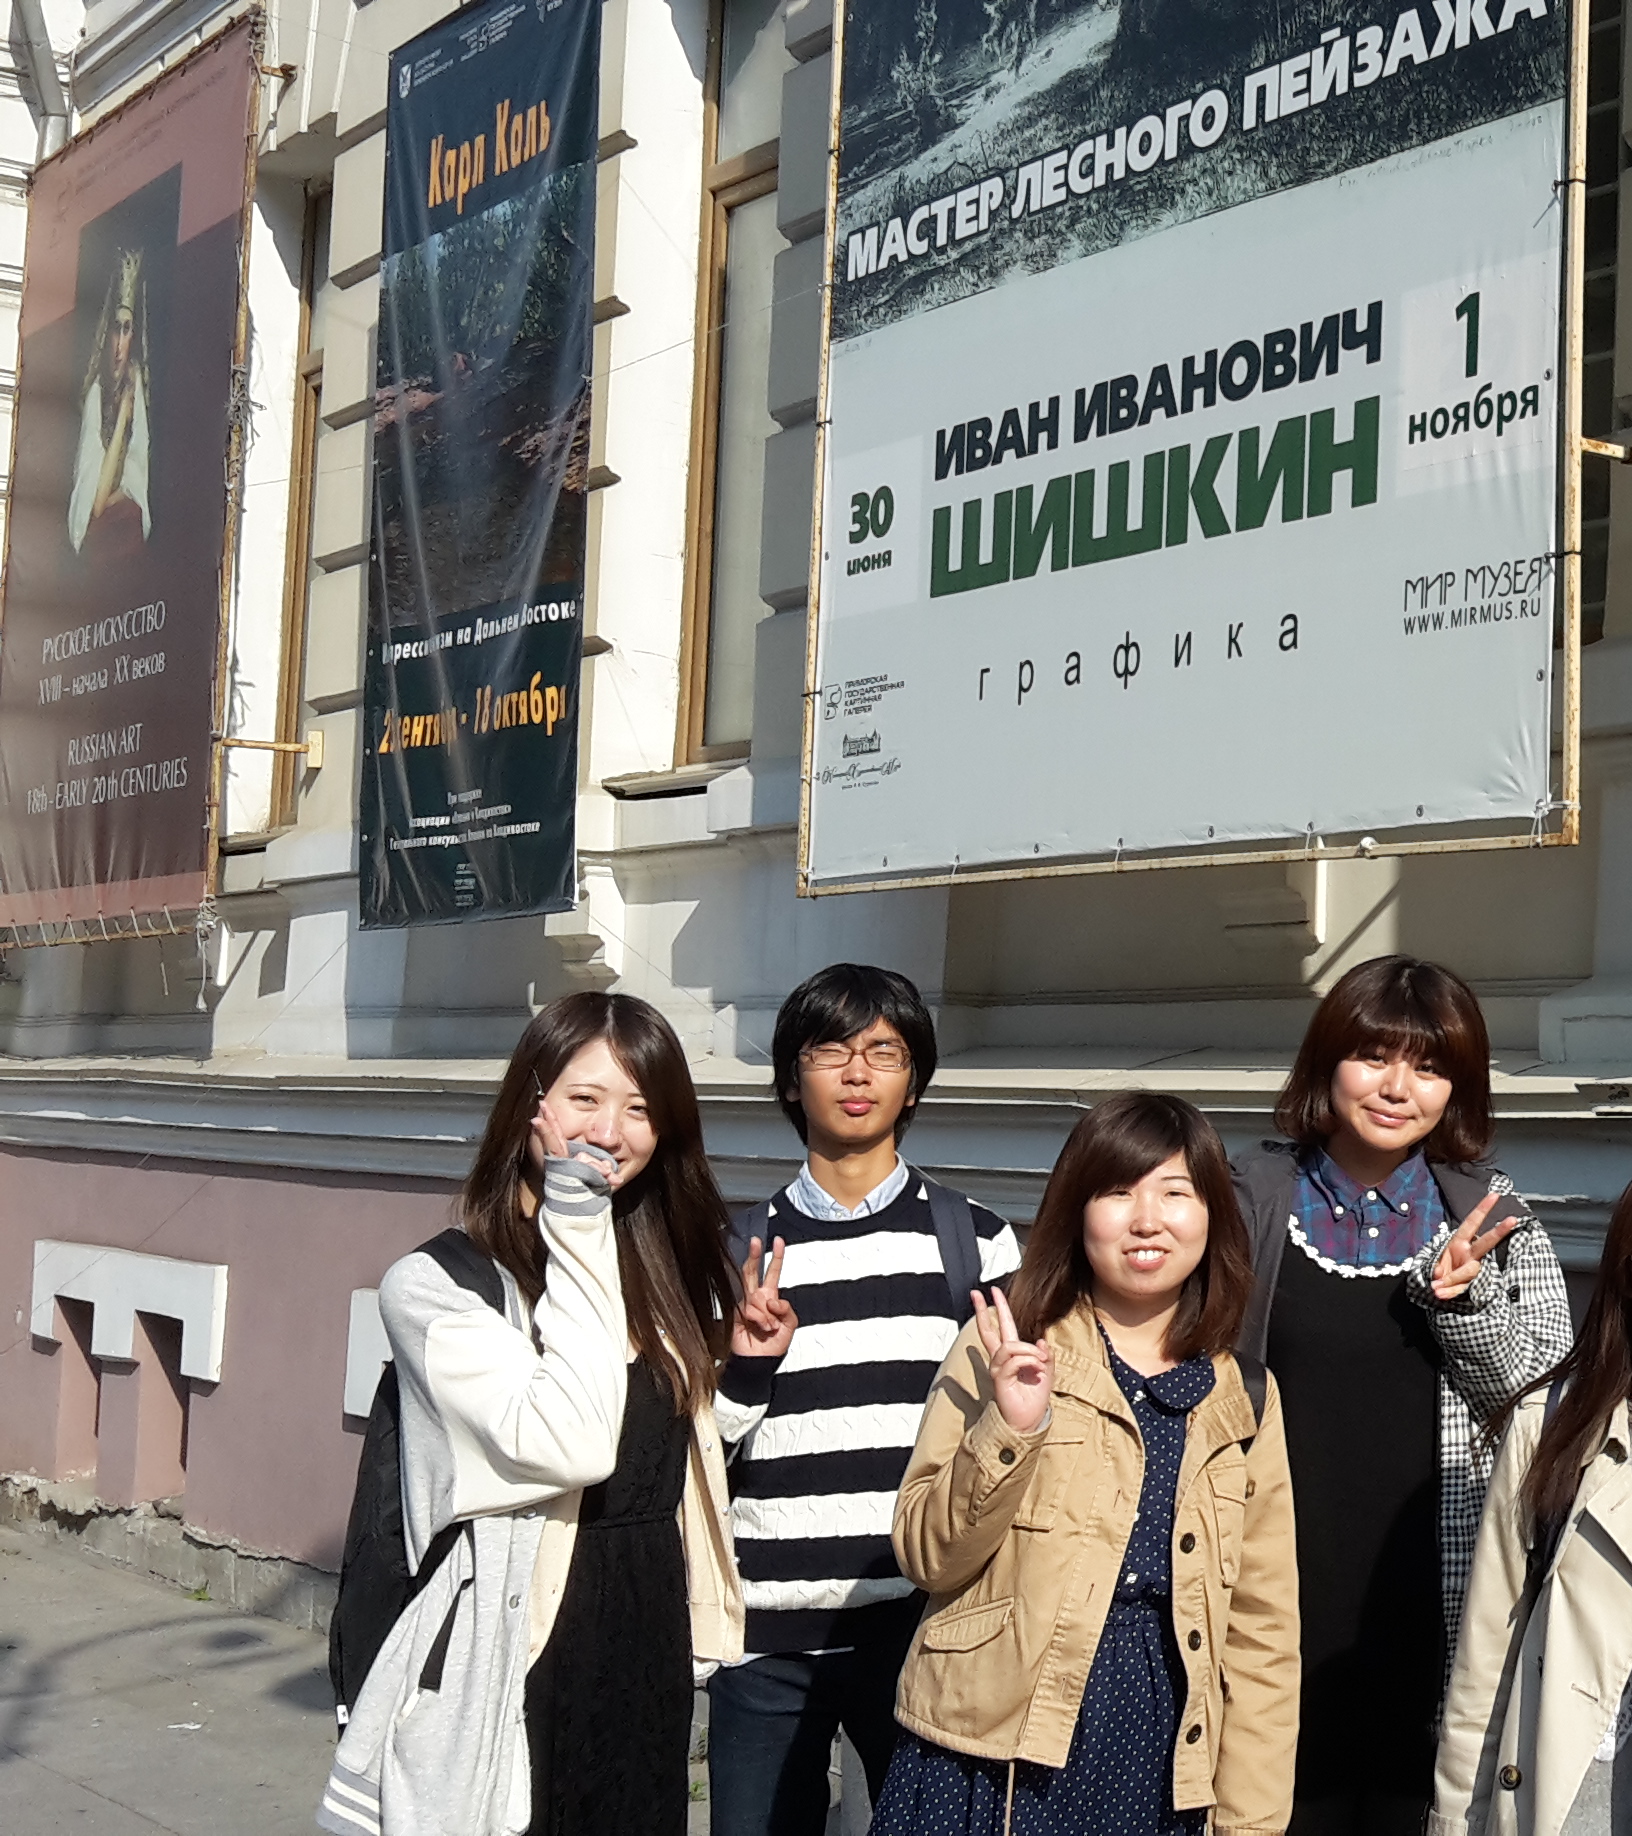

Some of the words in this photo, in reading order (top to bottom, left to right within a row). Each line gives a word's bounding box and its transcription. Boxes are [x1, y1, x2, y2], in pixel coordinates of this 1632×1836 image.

[428, 133, 486, 215] Карл
[494, 98, 550, 176] Каль
[847, 176, 1004, 282] МАСТЕР
[1011, 88, 1229, 219] ЛЕСНОГО
[1455, 291, 1480, 378] 1
[934, 395, 1060, 482] ИВАН
[1073, 299, 1383, 444] ИВАНОВИЧ
[1408, 382, 1539, 445] ноября
[848, 485, 894, 545] 30
[929, 394, 1381, 599] ШИШКИН
[846, 549, 893, 577] июня
[1404, 571, 1456, 613] МИР
[1464, 557, 1543, 602] МУЗЕЯ
[42, 624, 91, 664] РУССКОЕ
[92, 600, 166, 650] ИСКУССТВО
[456, 626, 472, 645] на
[474, 612, 520, 646] Дальнем
[520, 600, 576, 626] Востоке
[1403, 597, 1541, 636] WWW.MIRMUS.RU
[72, 668, 109, 697] начала
[113, 653, 131, 685] XX
[132, 651, 166, 680] веков
[978, 613, 1298, 706] графика
[474, 684, 492, 735] 18
[493, 670, 567, 736] октября
[68, 730, 117, 766] RUSSIAN
[118, 723, 144, 755] ART
[55, 777, 90, 810] EARLY
[120, 756, 188, 798] CENTURIES
